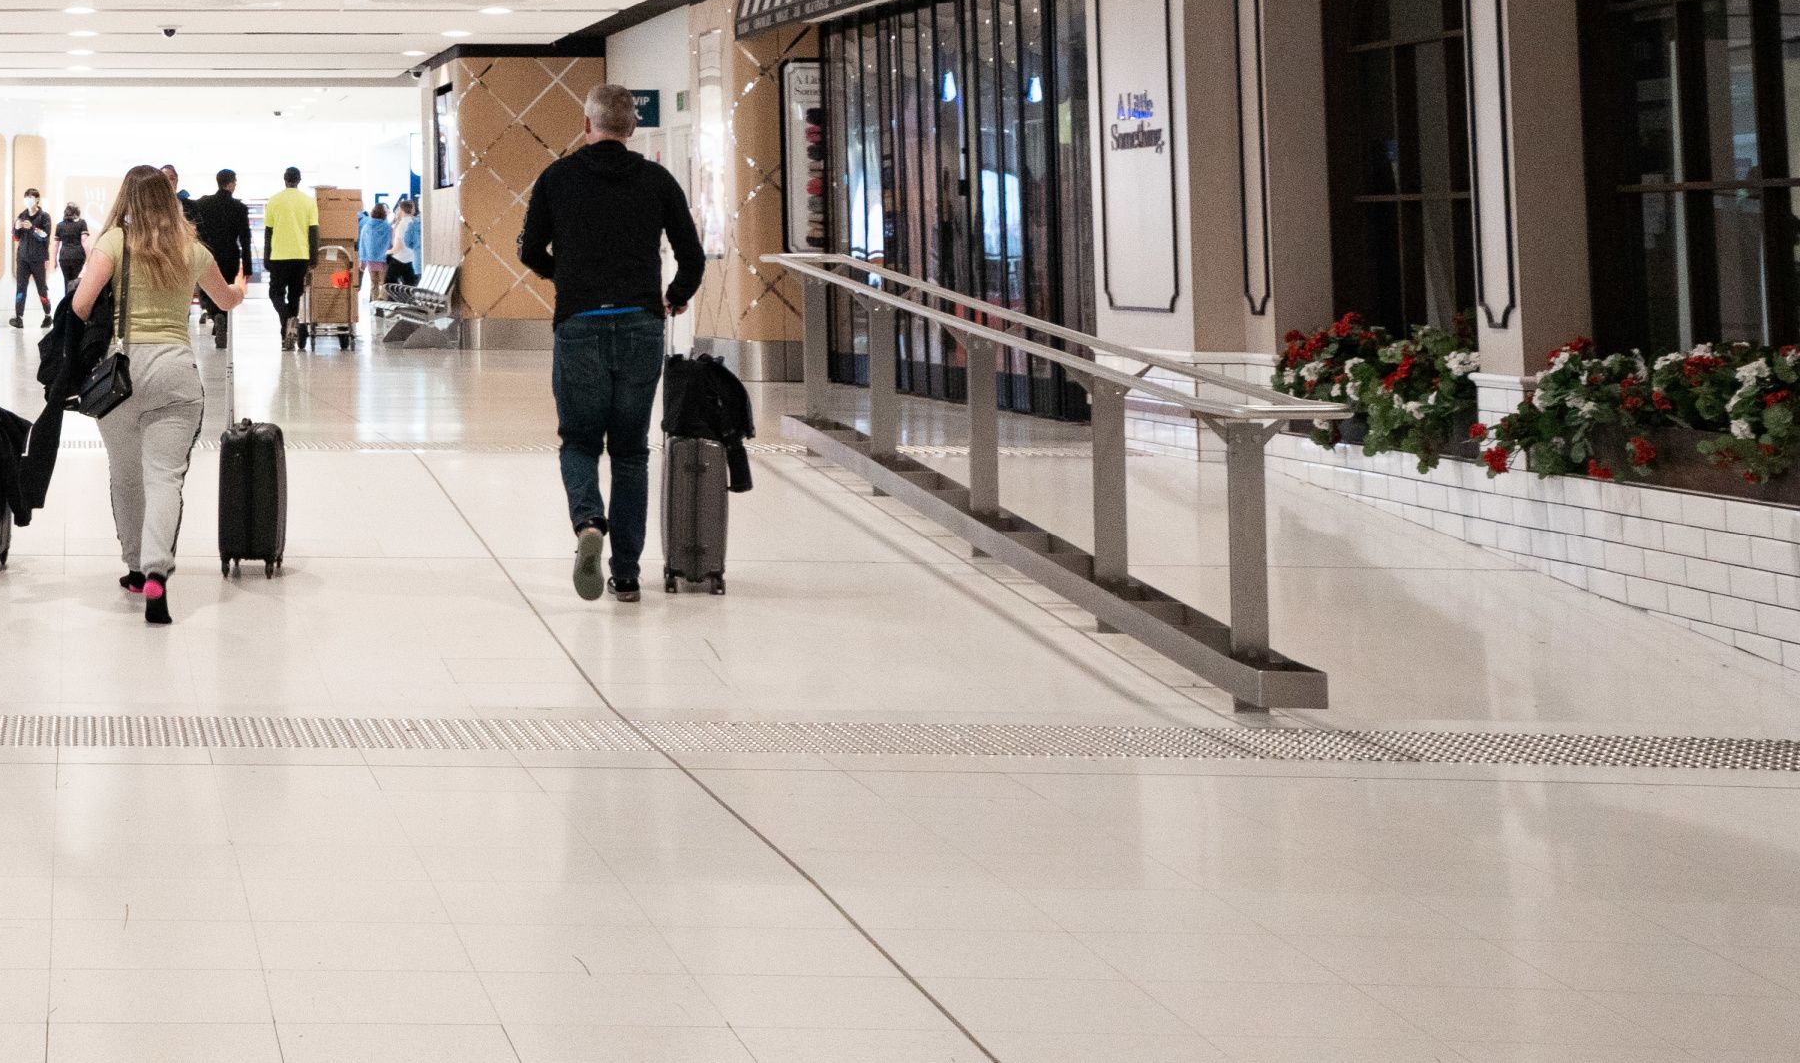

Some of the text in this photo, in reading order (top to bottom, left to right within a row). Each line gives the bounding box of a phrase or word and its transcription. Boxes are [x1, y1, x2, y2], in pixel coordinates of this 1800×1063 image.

[1117, 90, 1154, 121] A Little
[1111, 120, 1165, 154] Something
